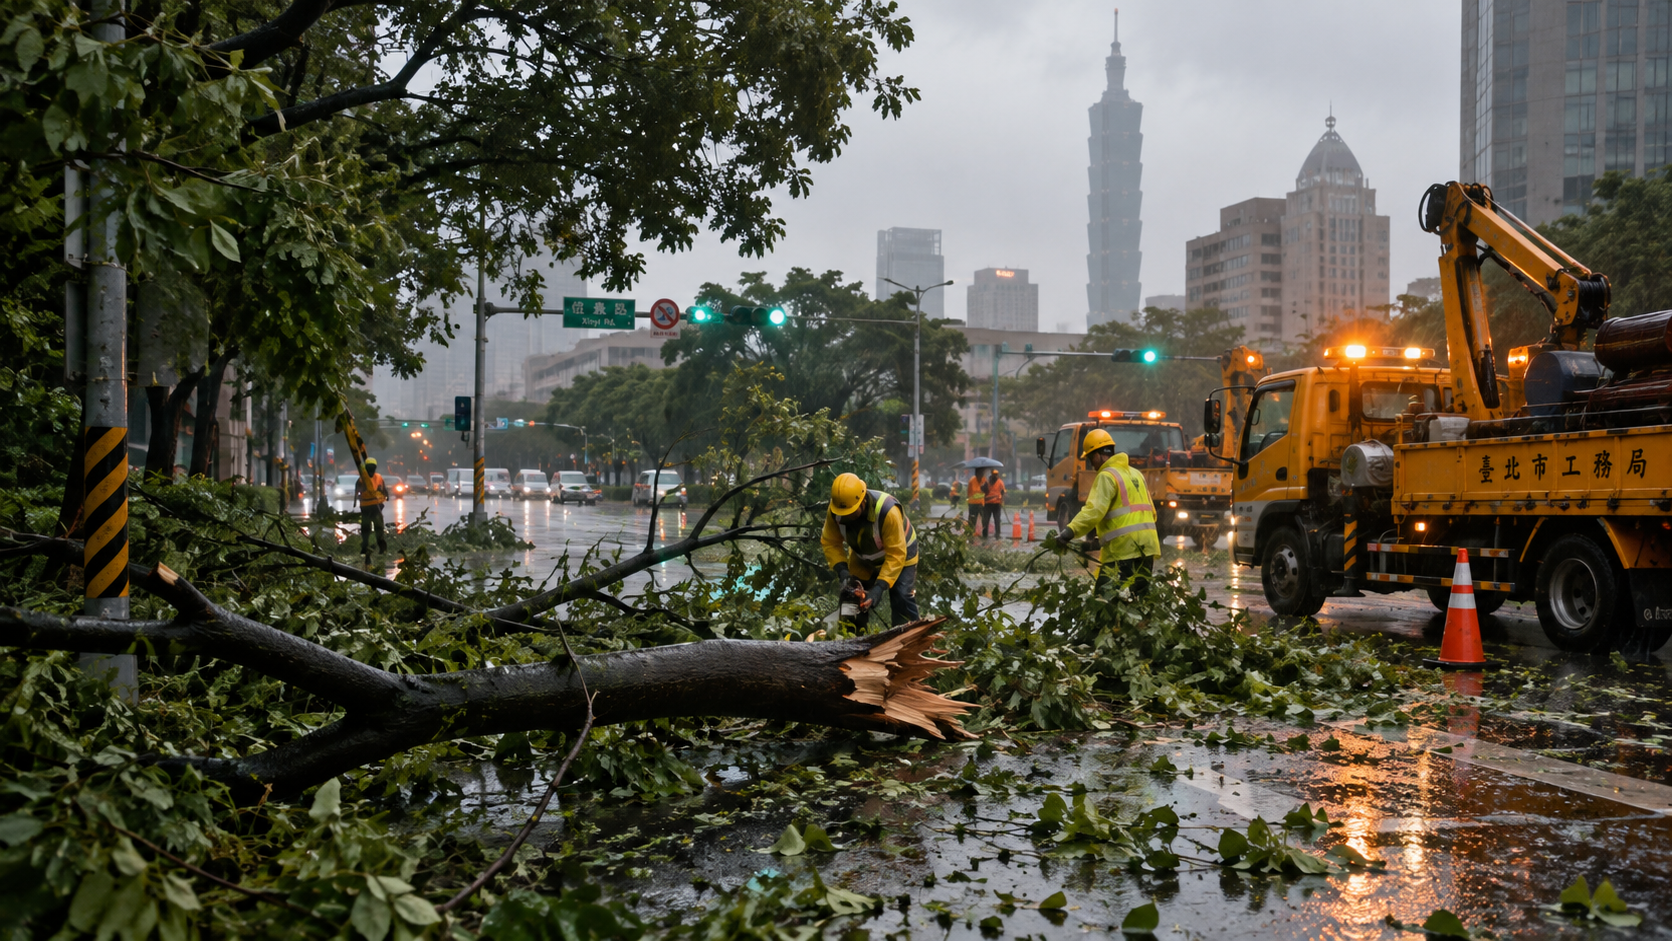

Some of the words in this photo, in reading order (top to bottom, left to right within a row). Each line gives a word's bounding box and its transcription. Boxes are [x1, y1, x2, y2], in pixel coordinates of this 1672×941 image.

[1478, 448, 1647, 484] 臺北市工務局
